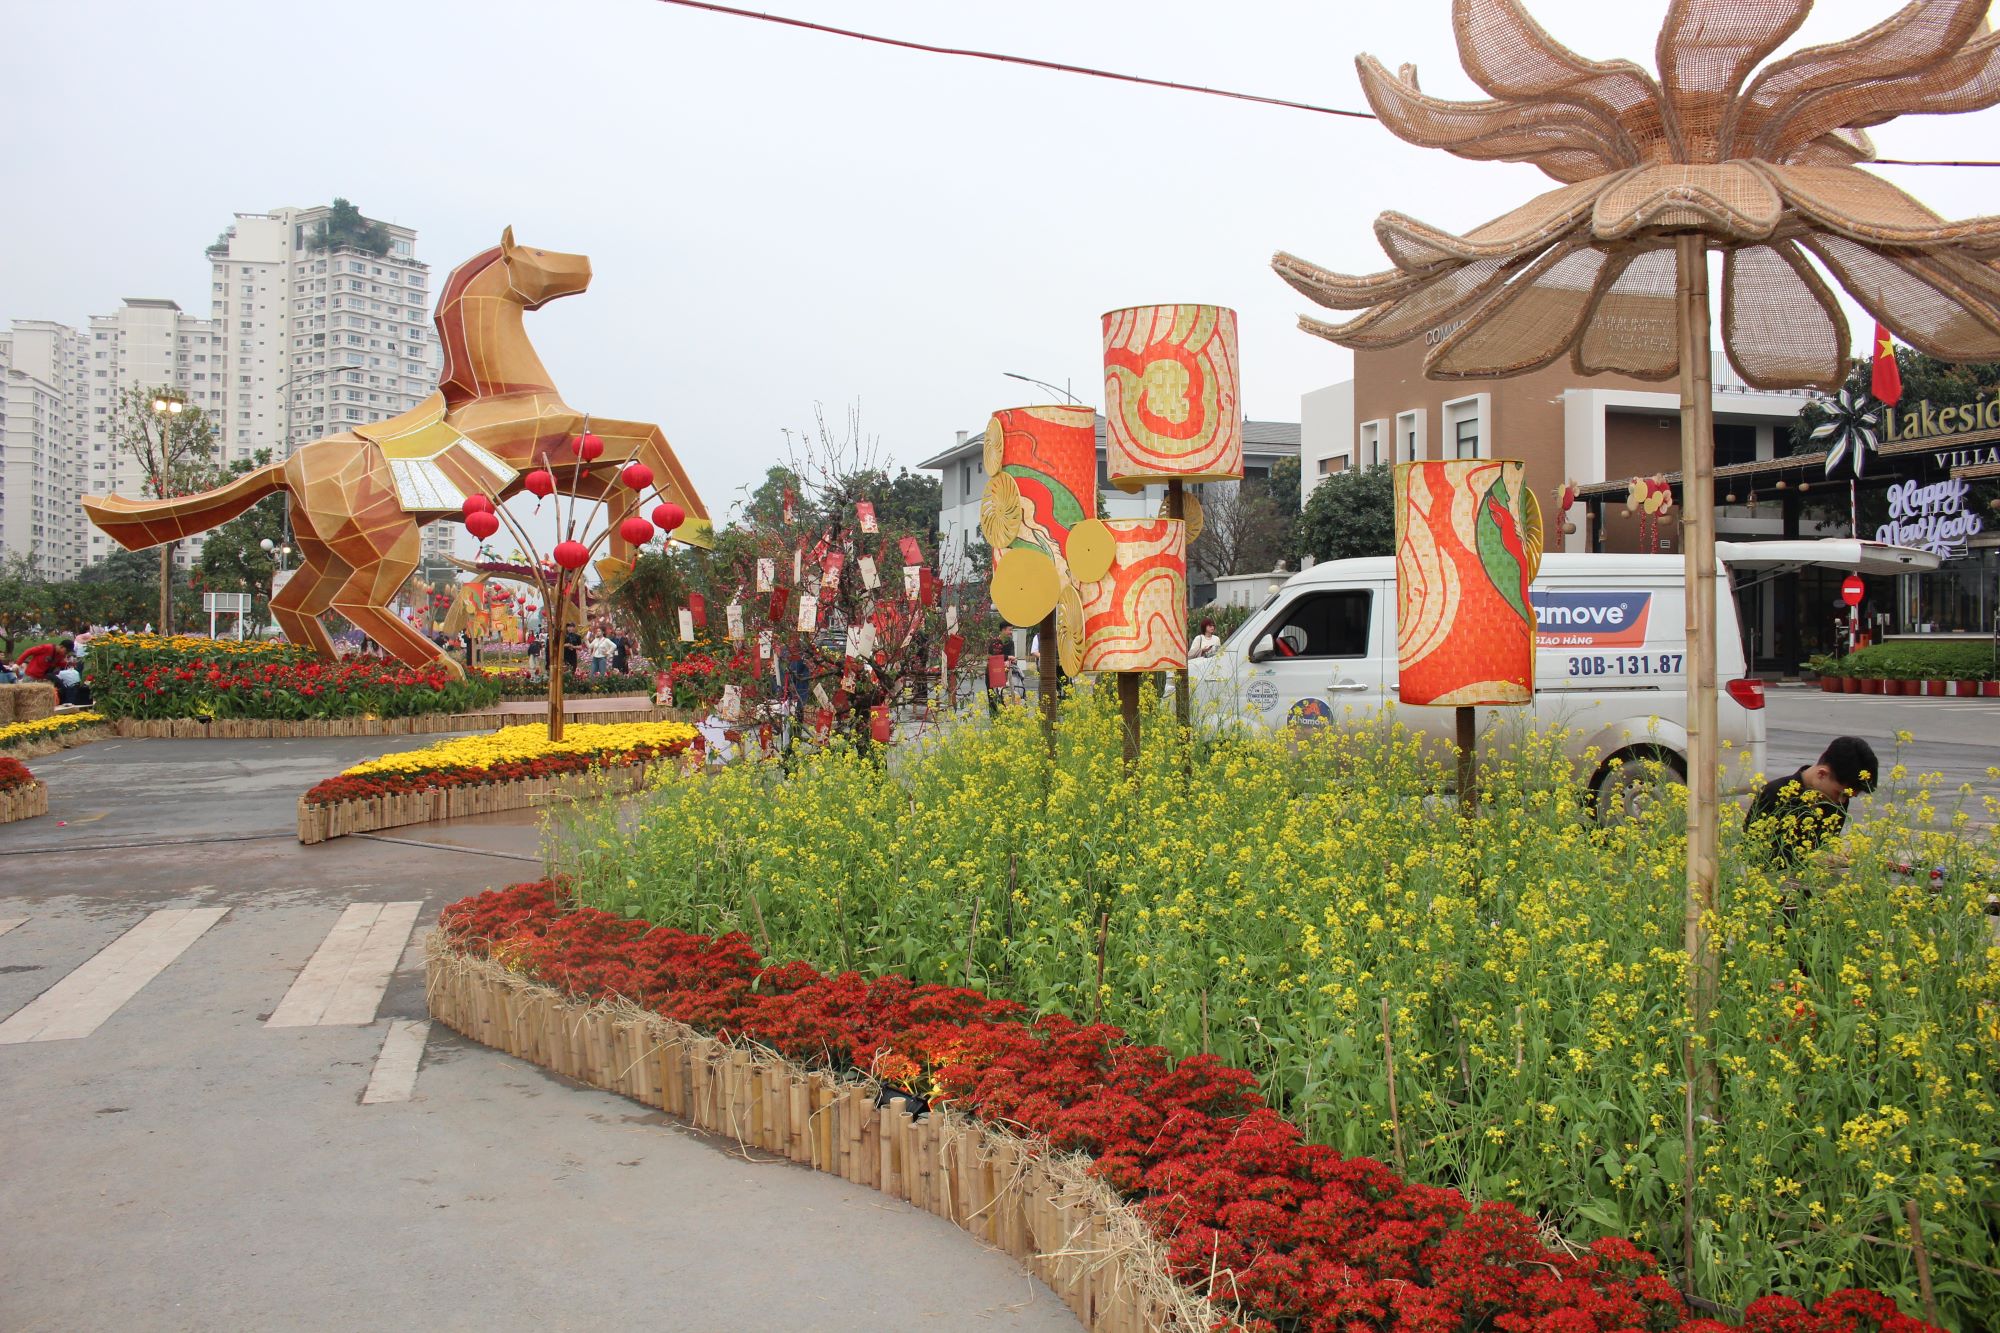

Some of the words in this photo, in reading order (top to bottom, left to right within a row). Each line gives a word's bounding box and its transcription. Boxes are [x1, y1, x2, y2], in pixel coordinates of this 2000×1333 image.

[1887, 478, 1969, 518] Happy
[1876, 516, 1928, 545] New
[1921, 509, 1982, 555] Year
[1568, 655, 1683, 676] 30B-131.87
